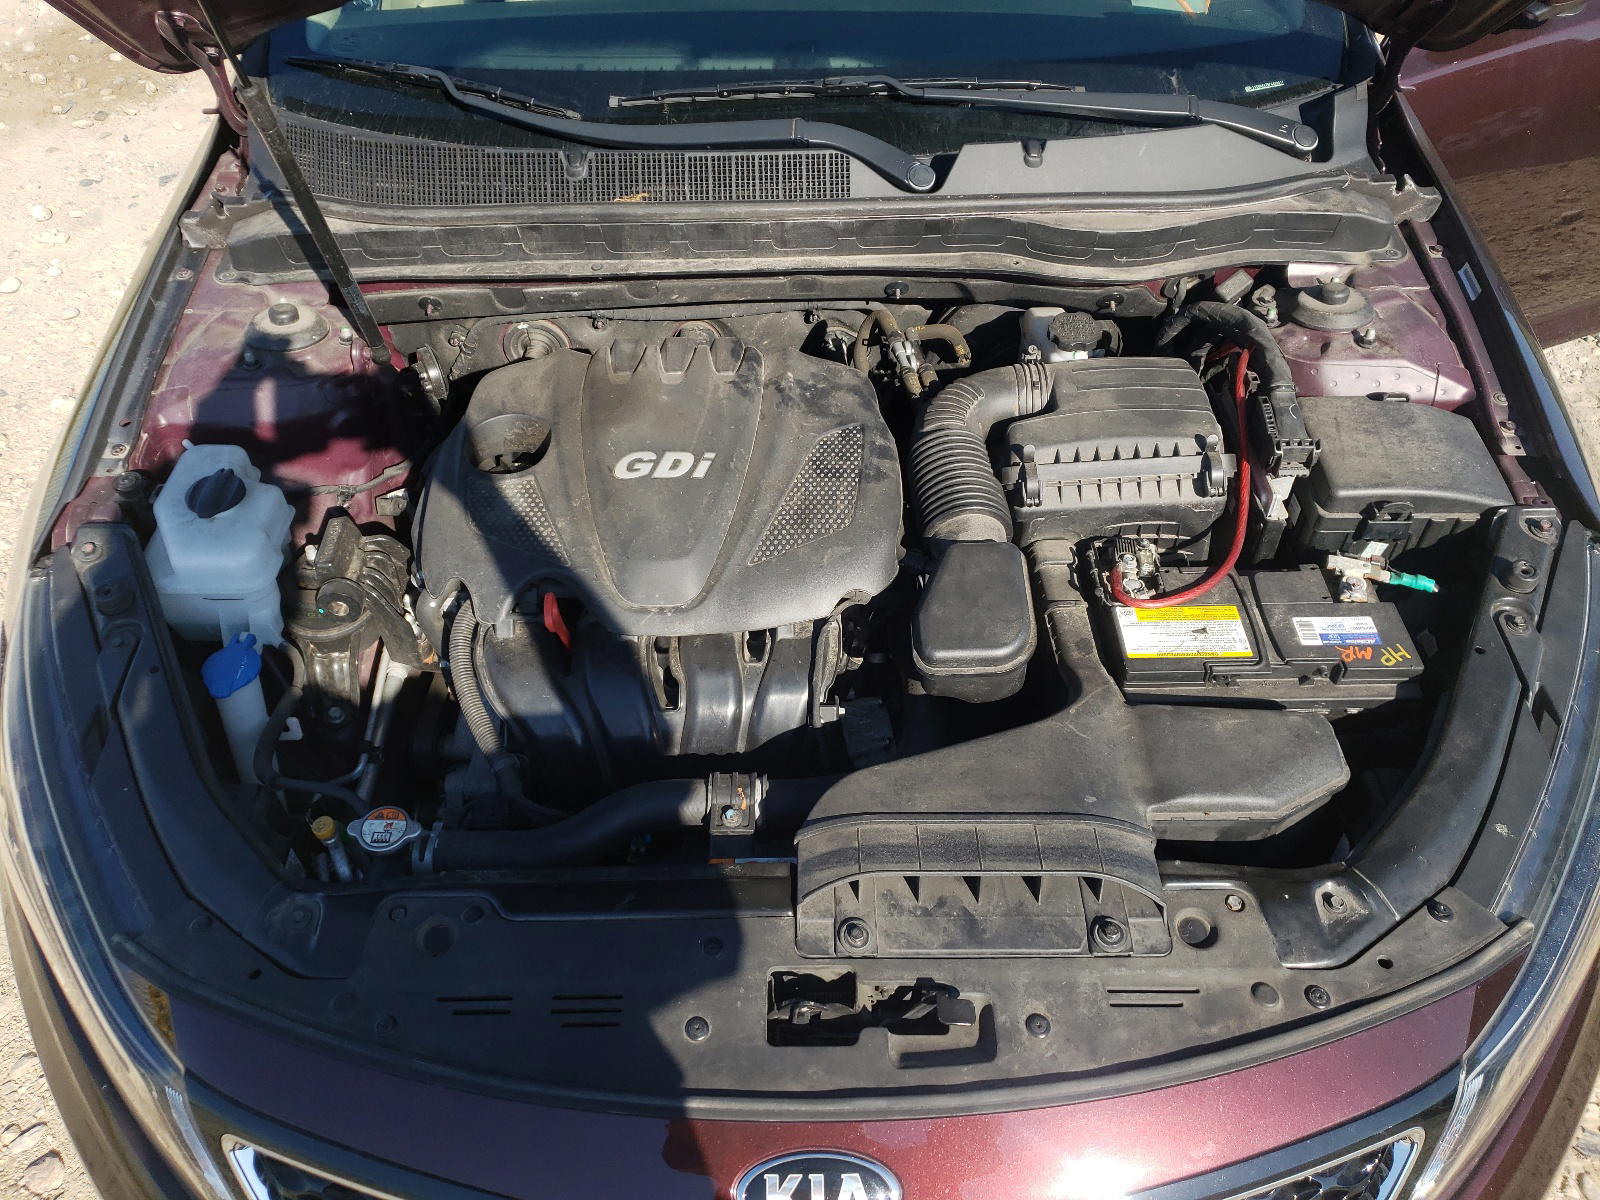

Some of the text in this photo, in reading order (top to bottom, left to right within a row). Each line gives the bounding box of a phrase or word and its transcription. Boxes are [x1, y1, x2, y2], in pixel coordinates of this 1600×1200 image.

[613, 450, 717, 480] GDi
[1334, 645, 1373, 663] MR
[1380, 643, 1412, 667] HP
[763, 1172, 868, 1200] KIA
